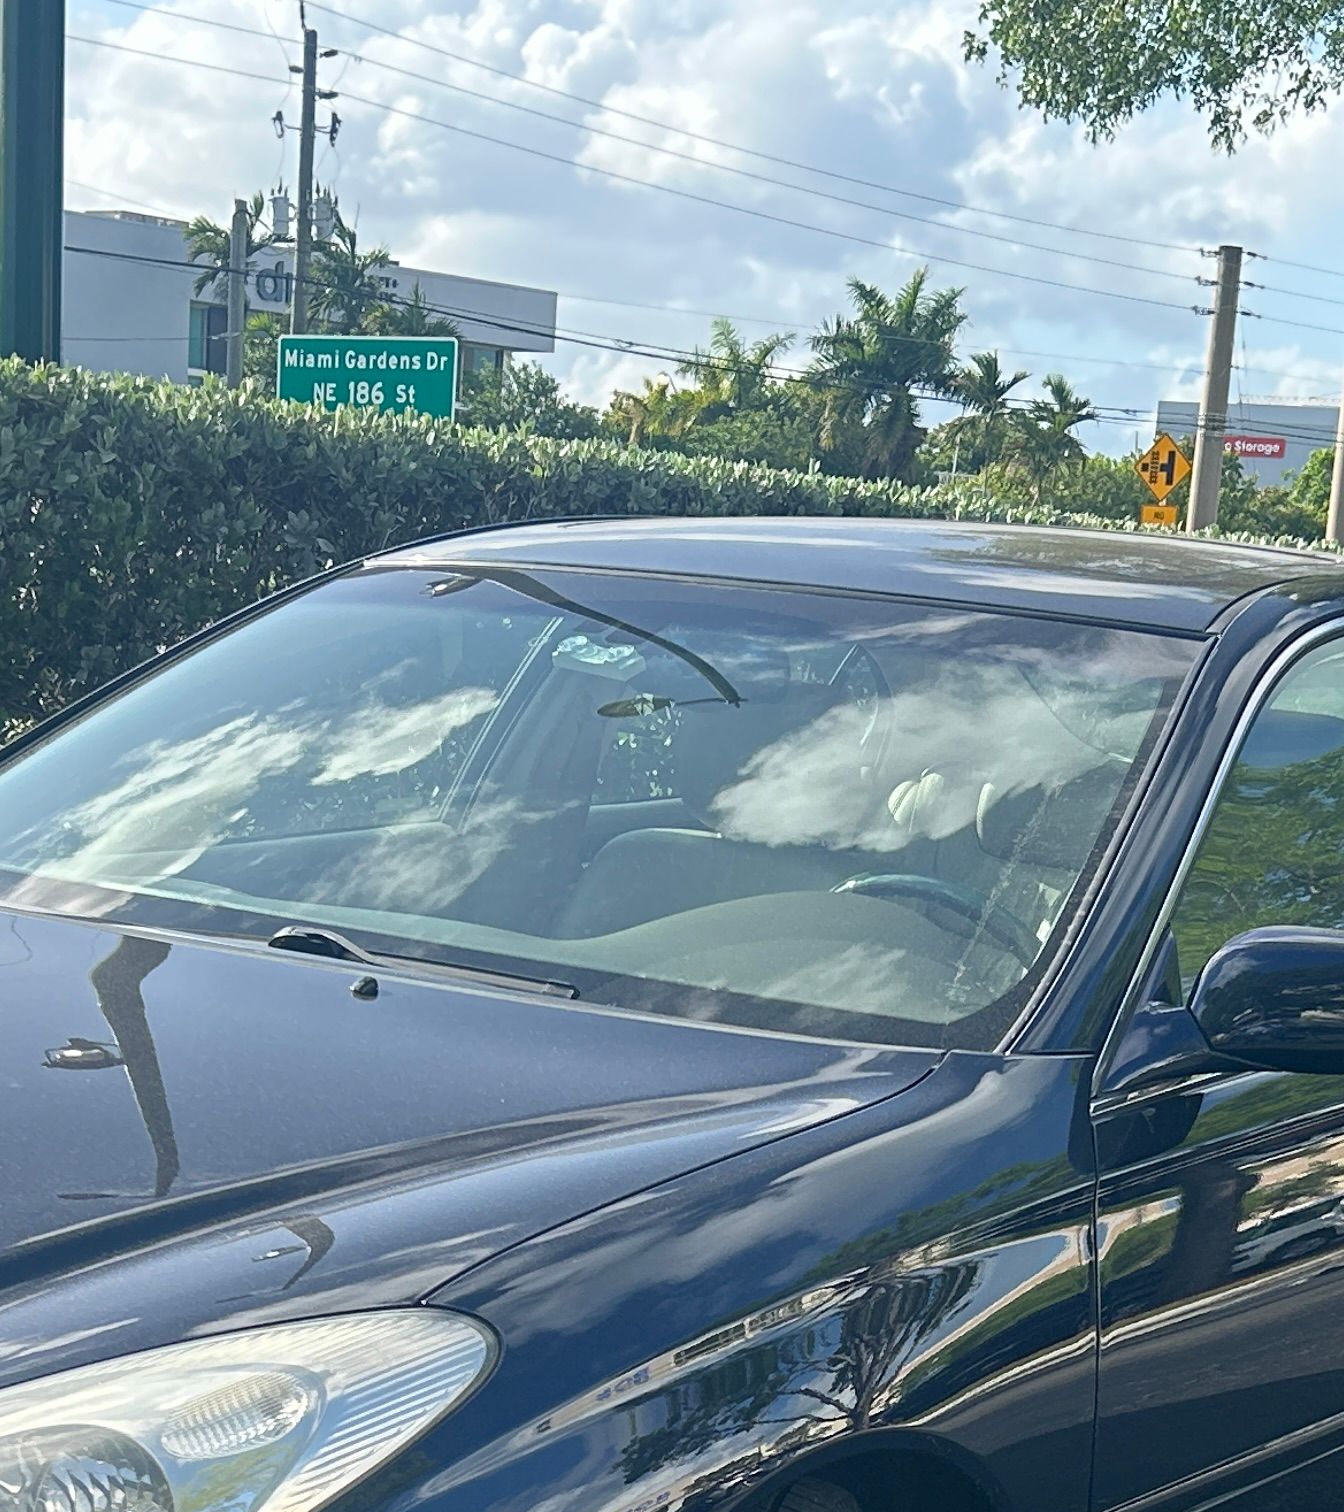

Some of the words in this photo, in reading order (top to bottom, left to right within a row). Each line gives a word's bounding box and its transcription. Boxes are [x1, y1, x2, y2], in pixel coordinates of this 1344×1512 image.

[284, 349, 340, 369] Miami
[344, 351, 421, 371] Gardens
[426, 353, 449, 371] Dr
[313, 382, 337, 402] NE
[348, 381, 384, 405] 186
[395, 383, 416, 404] St
[1234, 440, 1280, 456] Storage
